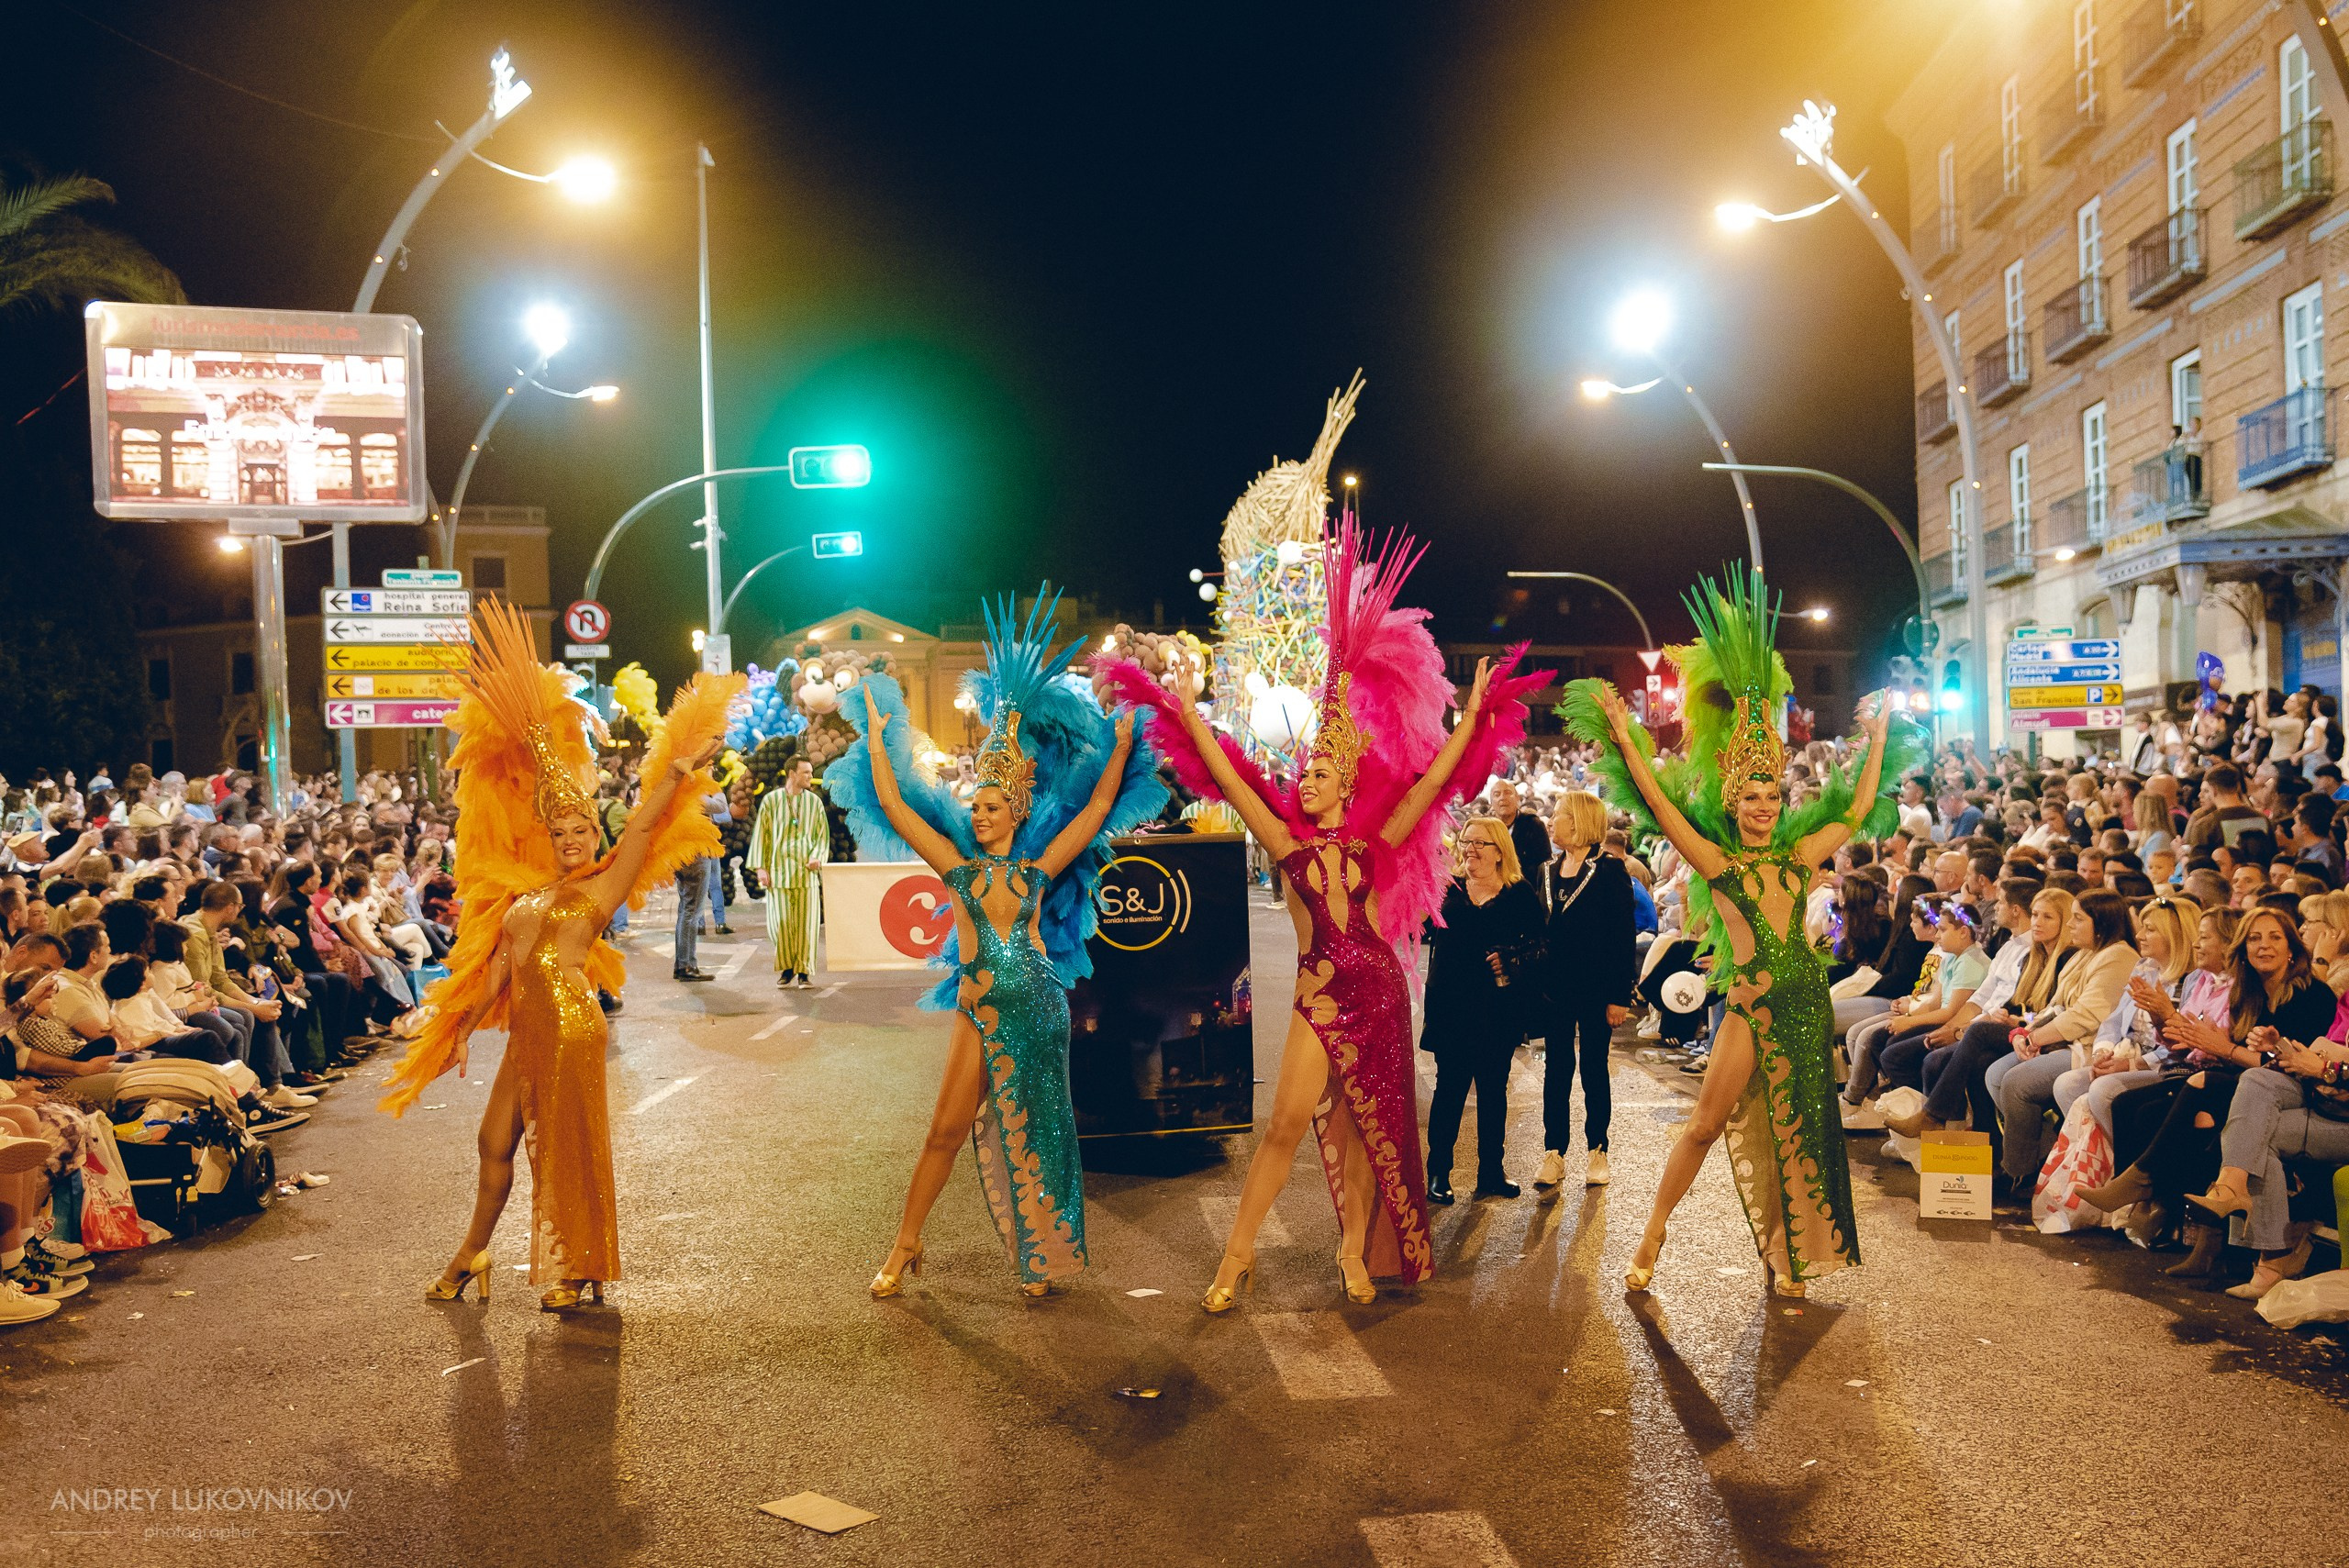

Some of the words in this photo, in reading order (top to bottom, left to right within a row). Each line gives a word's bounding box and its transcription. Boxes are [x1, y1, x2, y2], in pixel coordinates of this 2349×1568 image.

[384, 593, 425, 601] hospital
[431, 593, 468, 601] general
[384, 602, 422, 612] Reina
[352, 660, 392, 668] palacio
[377, 686, 391, 695] de
[398, 686, 414, 695] los
[1099, 883, 1164, 917] S&J
[1943, 1181, 1967, 1189] Dunia
